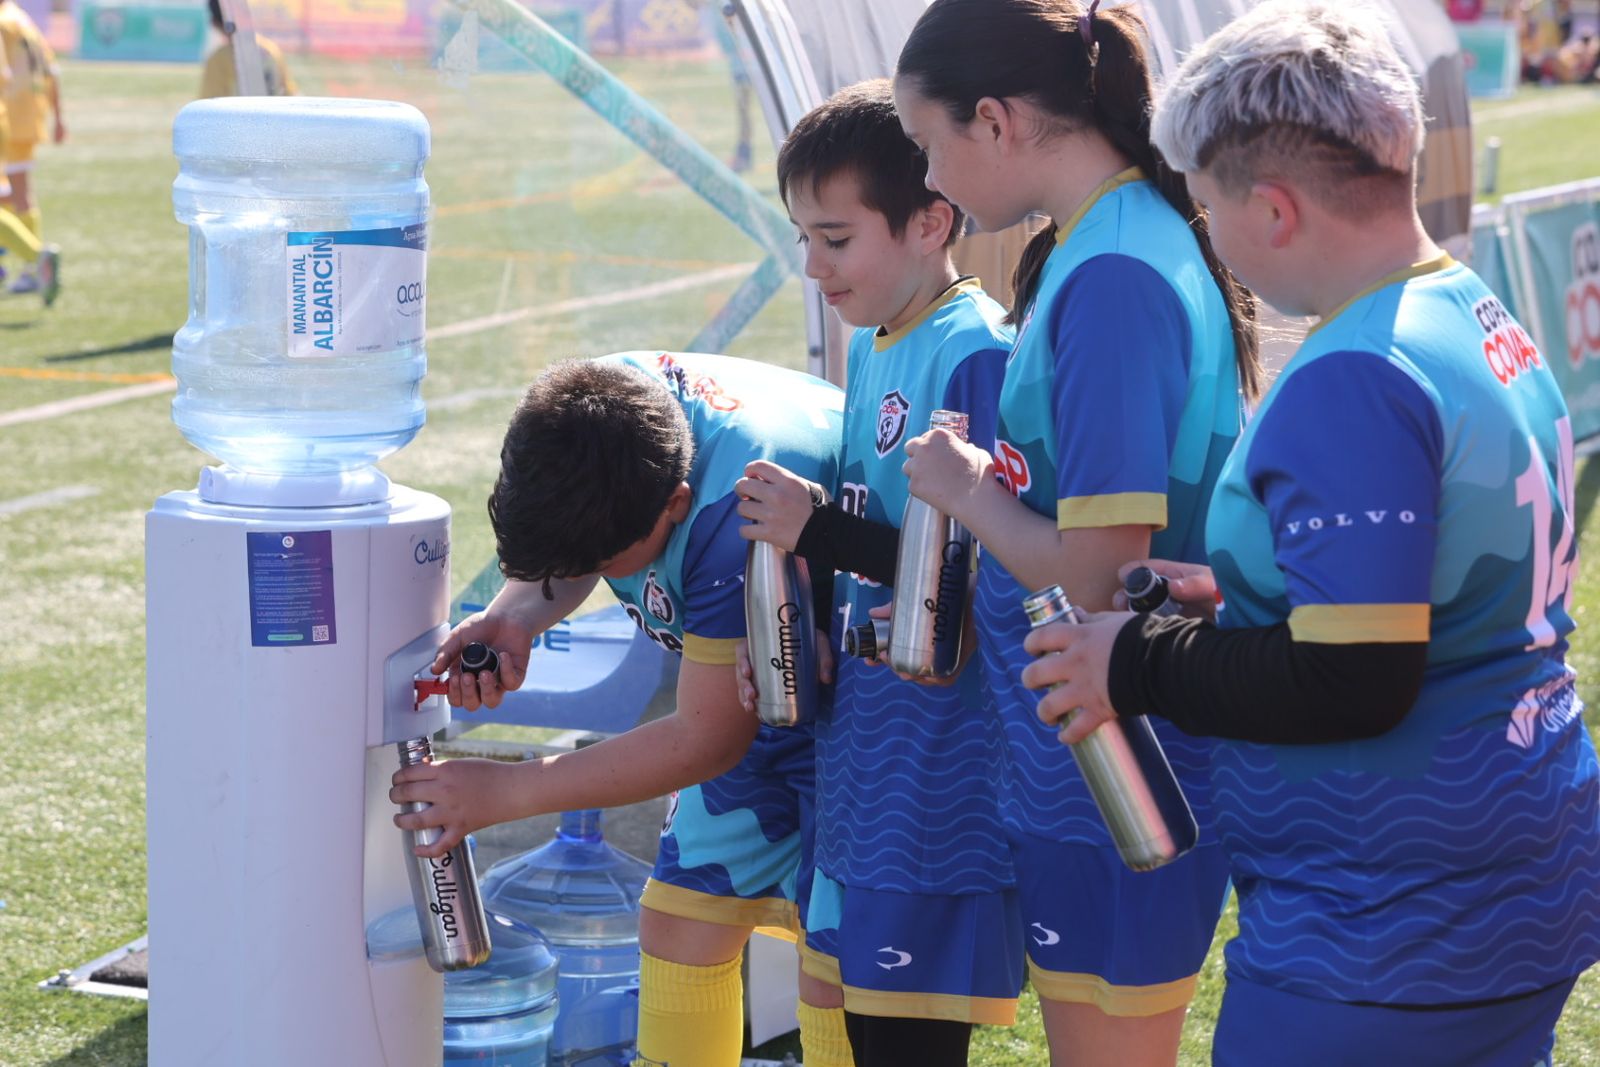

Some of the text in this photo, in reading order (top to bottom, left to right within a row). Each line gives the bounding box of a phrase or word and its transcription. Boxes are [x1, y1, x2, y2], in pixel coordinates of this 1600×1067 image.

[293, 254, 306, 335] MANANTIAL
[309, 236, 335, 351] ALBARCÍN
[1287, 509, 1416, 535] VOLVO
[771, 602, 802, 696] Culligan
[430, 851, 459, 939] Culligan
